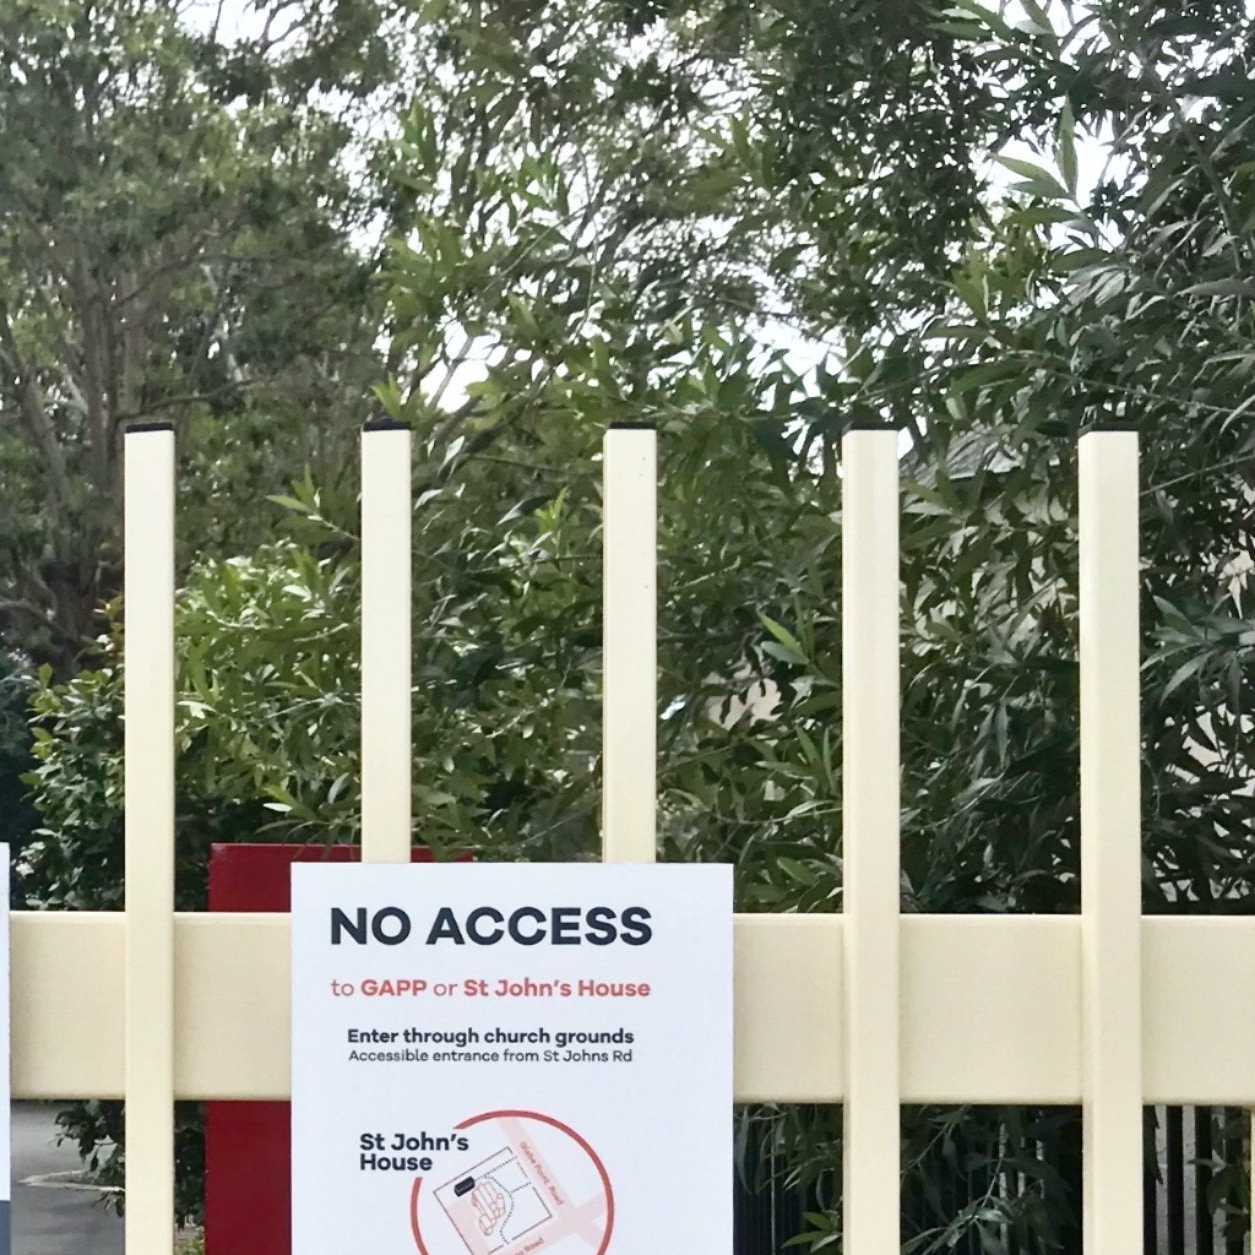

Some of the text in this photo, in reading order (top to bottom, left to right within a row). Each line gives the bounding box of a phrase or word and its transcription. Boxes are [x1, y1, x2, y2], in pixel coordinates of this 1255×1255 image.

[330, 906, 653, 946] NO ACCESS
[330, 977, 652, 998] to GAPP or St John's House
[347, 1026, 635, 1048] Enter through church grounds
[348, 1047, 633, 1063] Accessible entrance from St Johns Rd
[359, 1130, 470, 1152] St John's
[359, 1153, 434, 1172] House
